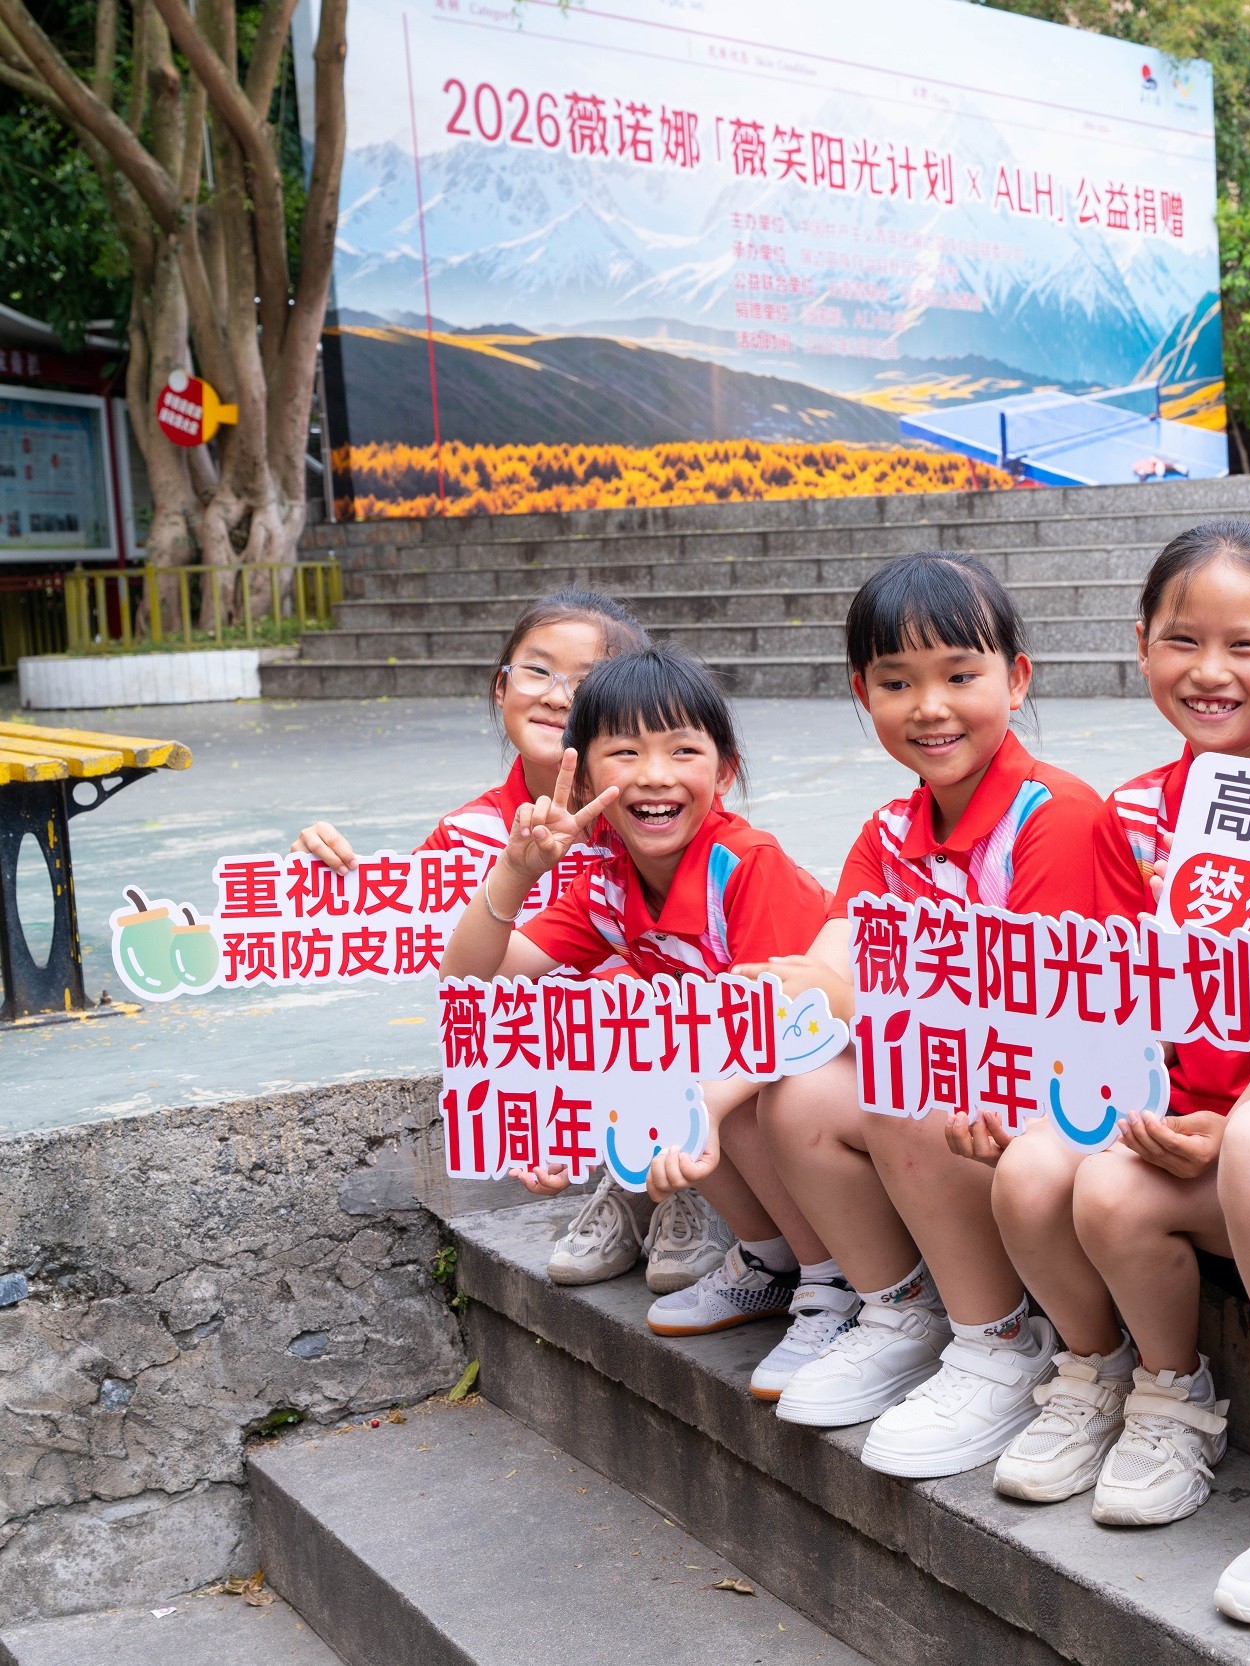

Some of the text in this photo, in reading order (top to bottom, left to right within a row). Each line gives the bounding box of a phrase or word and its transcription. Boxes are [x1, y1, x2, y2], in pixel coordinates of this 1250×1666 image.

[223, 924, 518, 981] 预防皮肤
[440, 980, 778, 1074] 薇笑阳光计划
[855, 1009, 1038, 1130] 11周年
[443, 1079, 597, 1177] 11周年
